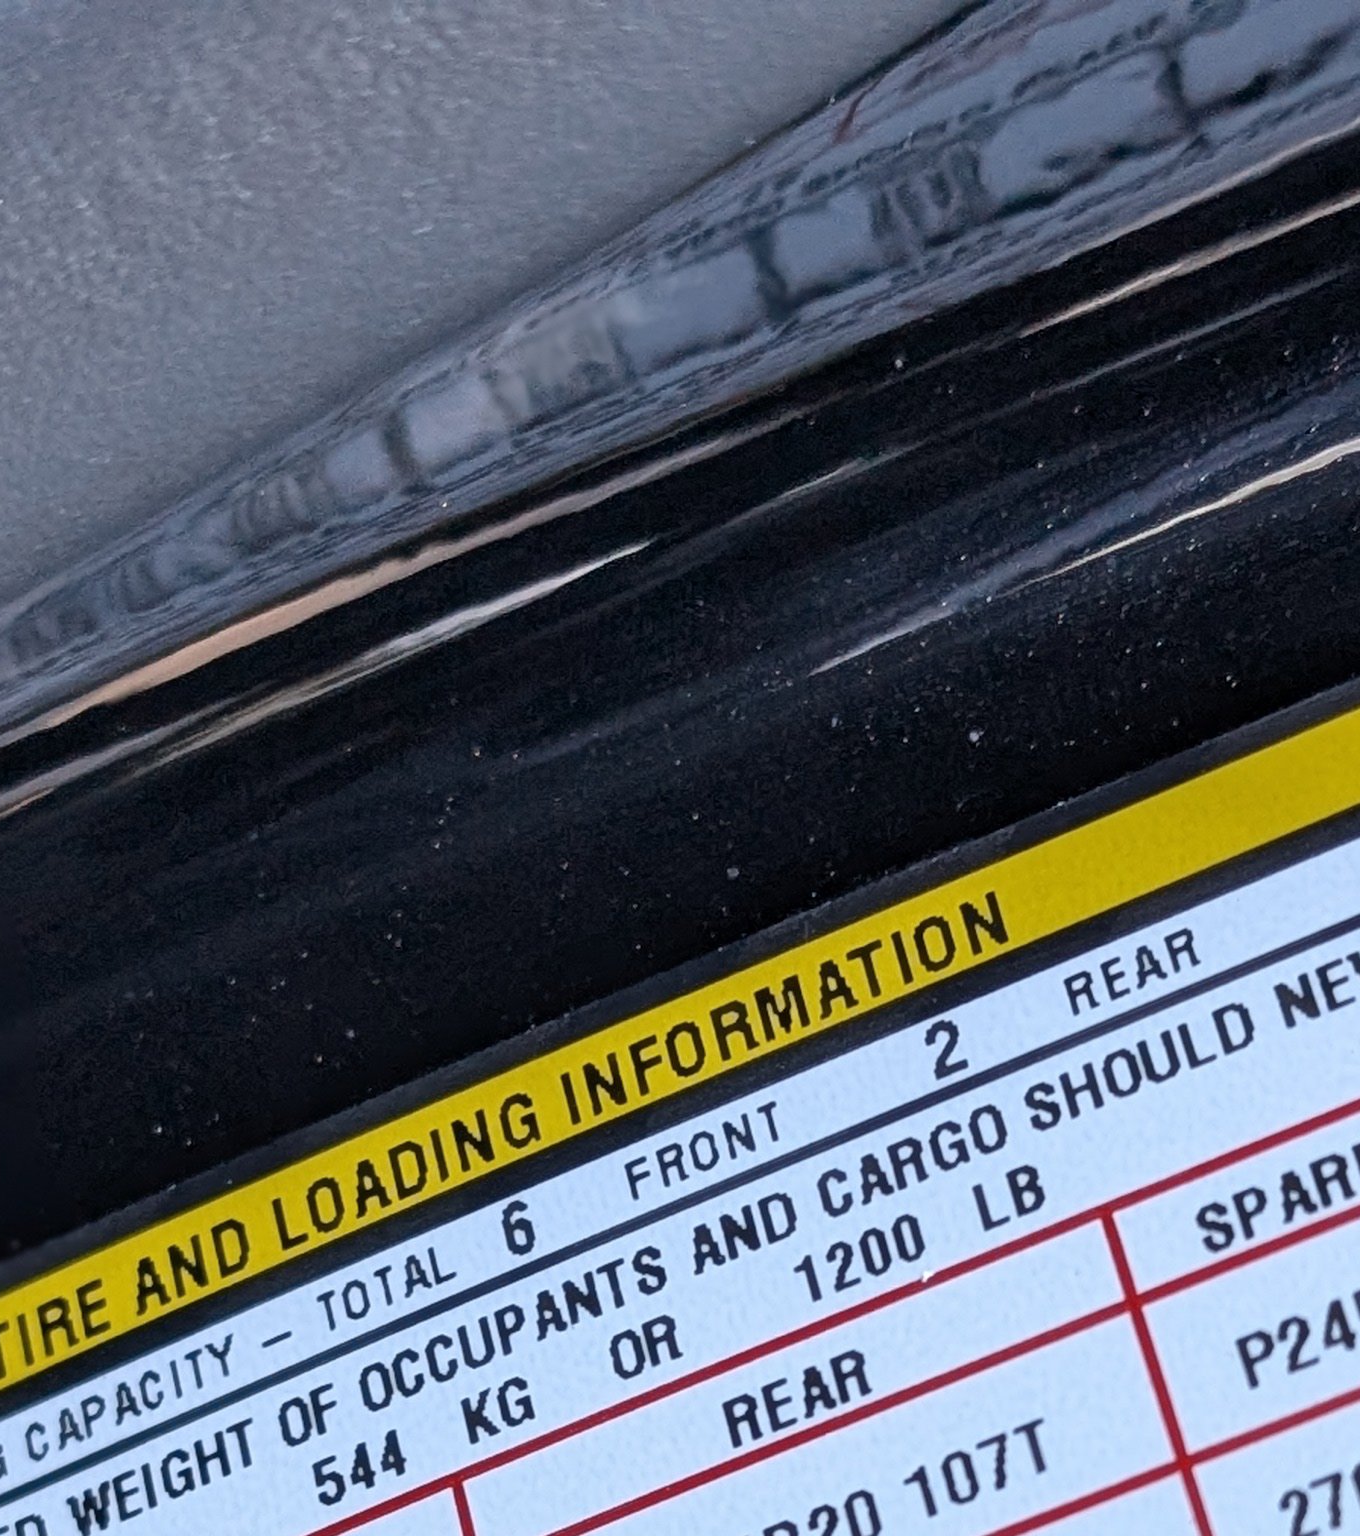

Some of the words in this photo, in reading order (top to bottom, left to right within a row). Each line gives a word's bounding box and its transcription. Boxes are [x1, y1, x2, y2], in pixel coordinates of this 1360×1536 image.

[22, 1331, 234, 1463] CAPACITY
[314, 1244, 458, 1332] TOTAL
[499, 1197, 537, 1257] 6
[621, 1098, 780, 1202] FRONT
[922, 1017, 970, 1081] 2
[1061, 925, 1202, 1017] REAR
[134, 1216, 251, 1317] AND
[269, 1090, 542, 1252] LOADING
[558, 888, 1010, 1127] INFORMATION
[276, 1381, 338, 1448] OF
[356, 1243, 669, 1413] OCCUPANTS
[691, 1190, 798, 1277] AND
[814, 1101, 1009, 1219] CARGO
[1022, 1000, 1256, 1133] SHOULD
[310, 1427, 408, 1507] 544
[458, 1374, 537, 1446] KG
[607, 1312, 684, 1381] OR
[791, 1211, 927, 1303] 1200
[970, 1162, 1047, 1233] LB
[720, 1347, 873, 1450] REAR
[901, 1416, 1048, 1518] 107T
